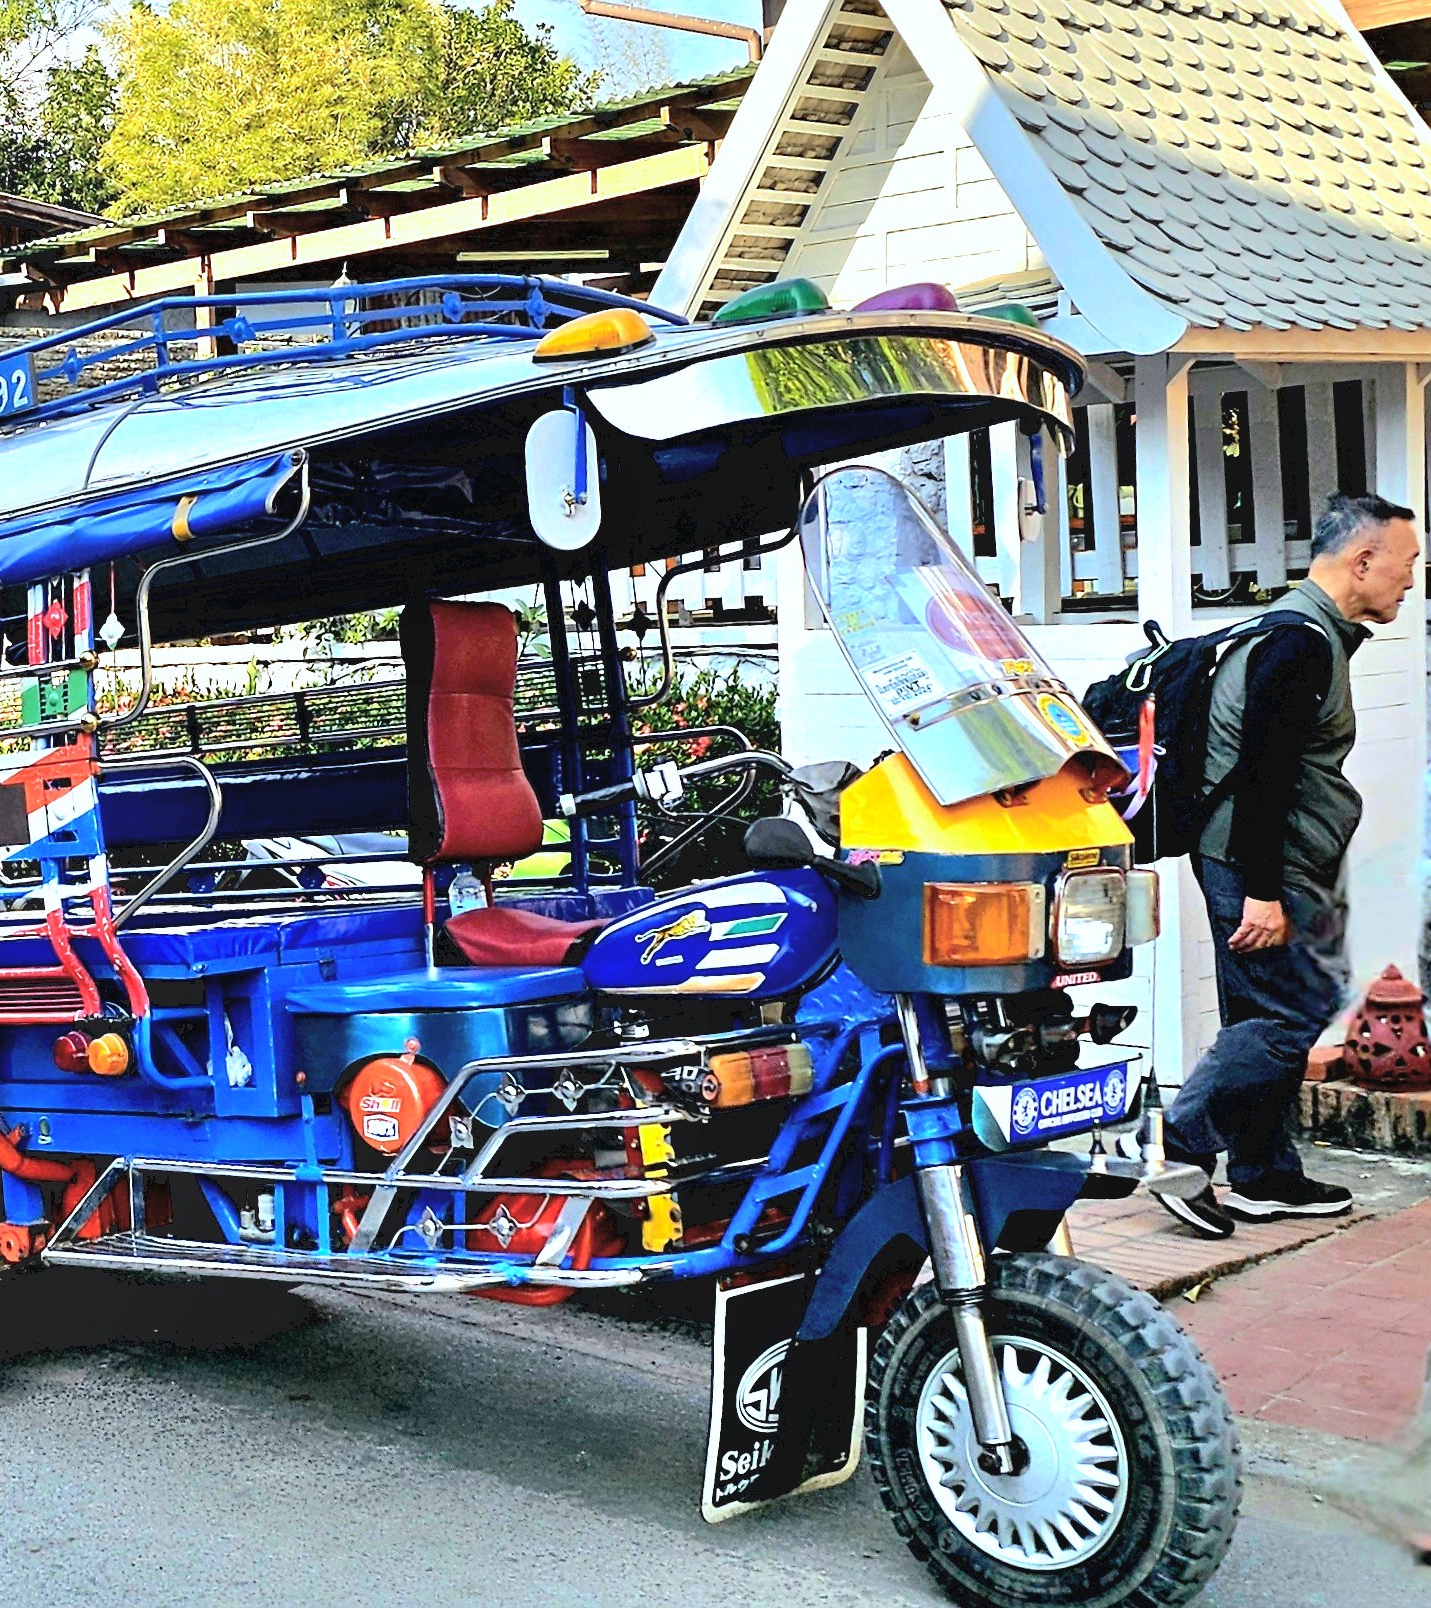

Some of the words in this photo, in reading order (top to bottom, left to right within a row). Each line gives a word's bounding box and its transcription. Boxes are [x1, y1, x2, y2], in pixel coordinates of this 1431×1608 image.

[1056, 971, 1098, 987] UNITED
[361, 1098, 400, 1111] Shll
[1040, 1080, 1103, 1116] CHELSEA
